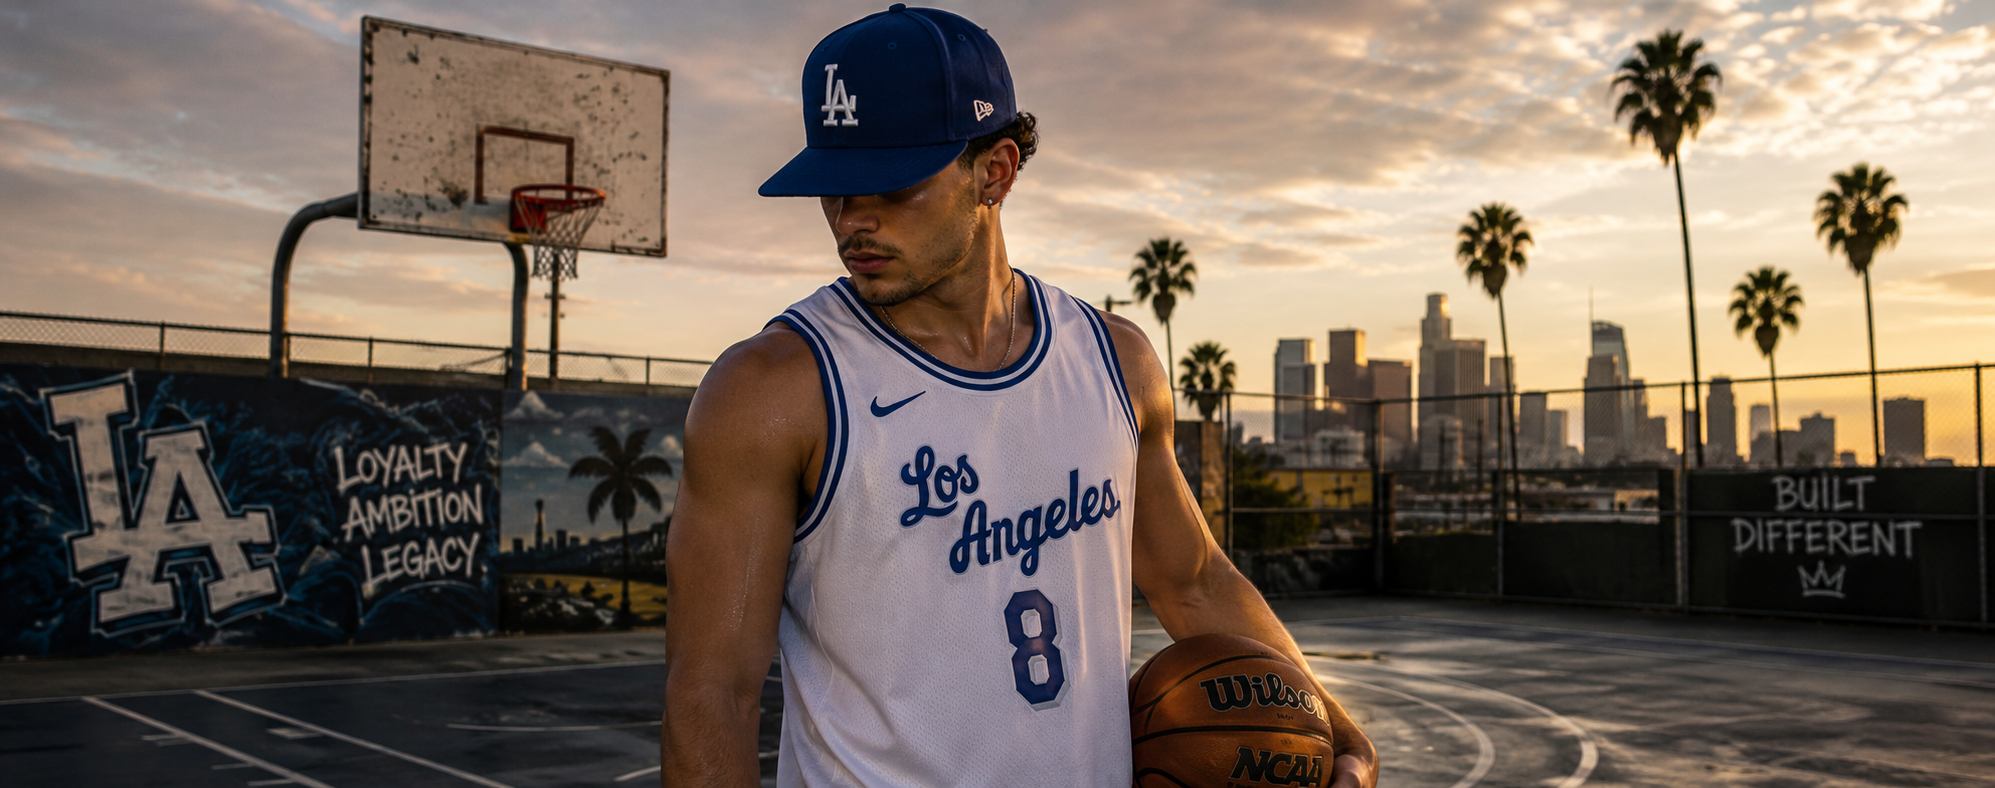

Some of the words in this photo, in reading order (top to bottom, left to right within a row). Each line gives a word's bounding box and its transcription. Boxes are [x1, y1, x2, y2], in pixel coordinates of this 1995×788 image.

[821, 63, 858, 126] LA
[335, 442, 467, 491] LOYALTY
[900, 444, 979, 527] Los
[1772, 474, 1876, 512] BUILT
[41, 373, 285, 635] LA
[341, 484, 482, 541] AMBITION
[949, 469, 1121, 576] Angeles
[363, 533, 480, 585] LEGACY
[1732, 517, 1922, 559] DIFFERENT
[1004, 589, 1069, 711] 8
[1229, 746, 1323, 788] NCAA
